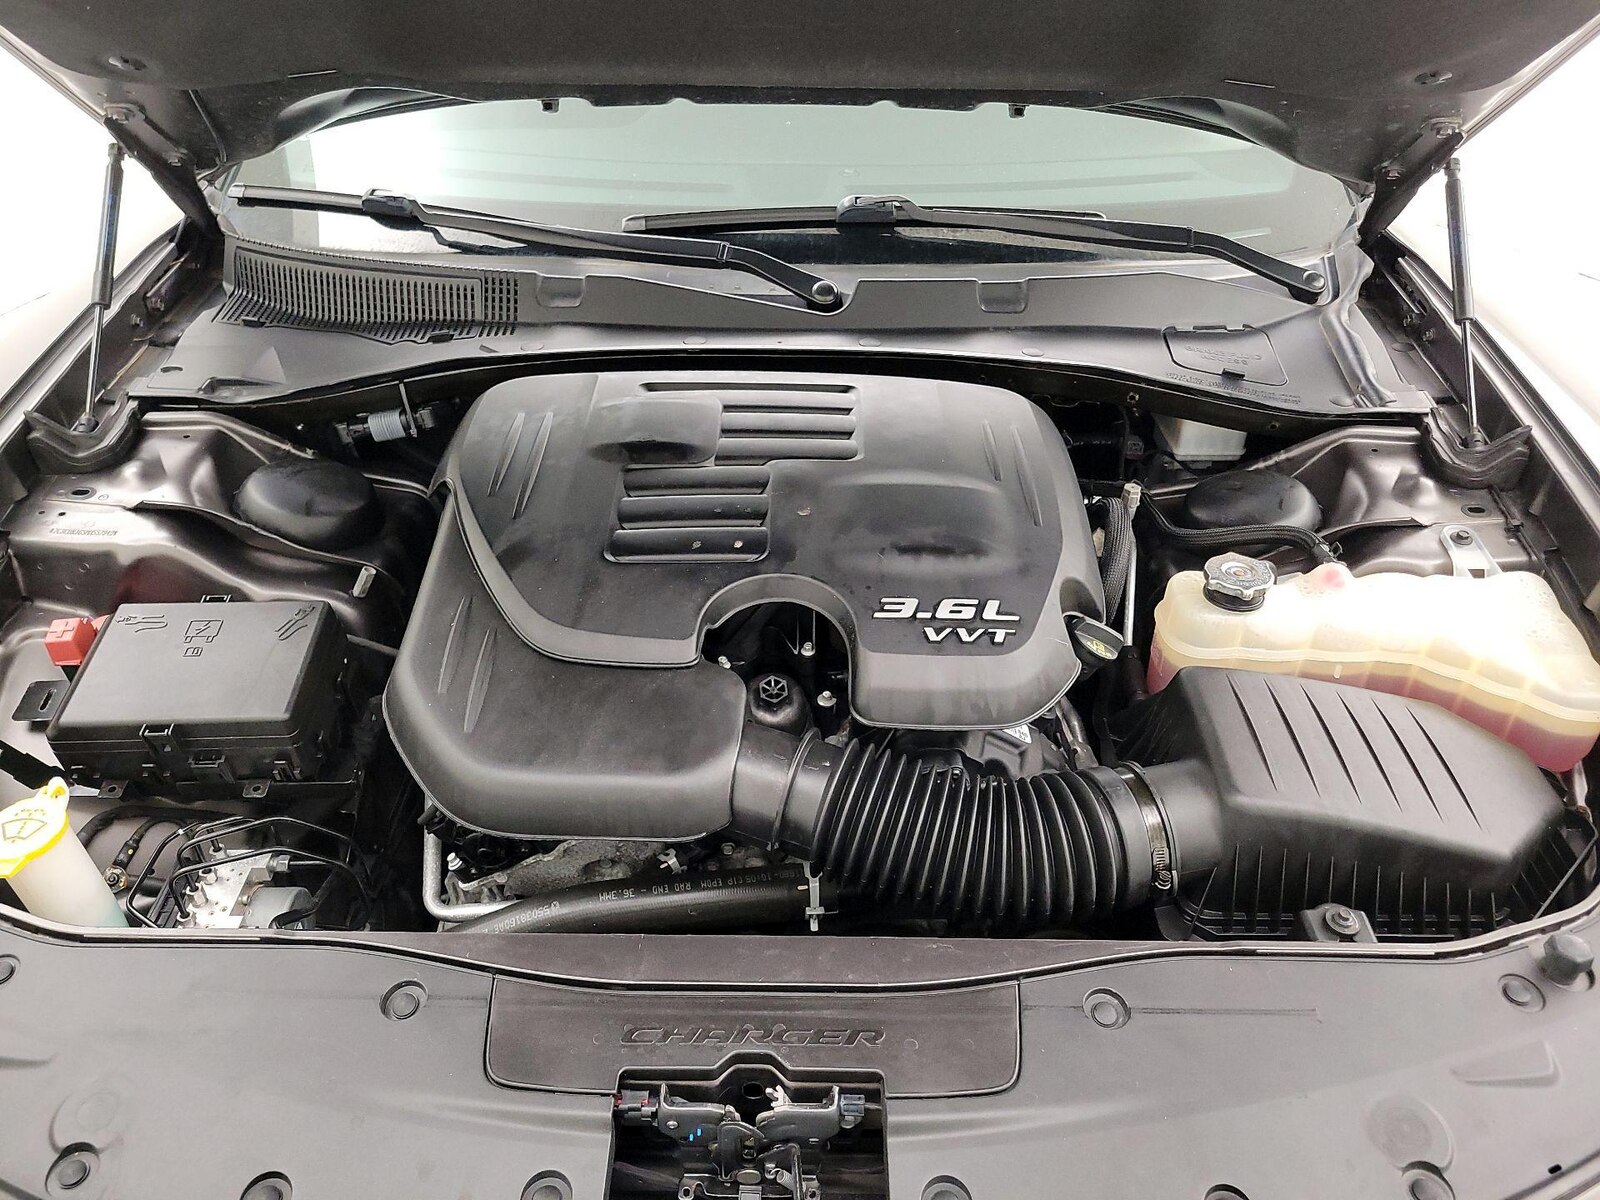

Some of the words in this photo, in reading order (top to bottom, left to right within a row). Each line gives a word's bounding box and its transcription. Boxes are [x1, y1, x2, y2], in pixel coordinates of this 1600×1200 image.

[872, 597, 1021, 622] 3.6L
[923, 627, 1017, 645] VVT
[652, 885, 669, 895] END
[675, 881, 691, 891] RAD
[599, 888, 635, 901] 36.3MM
[619, 1025, 886, 1048] CHARGER
